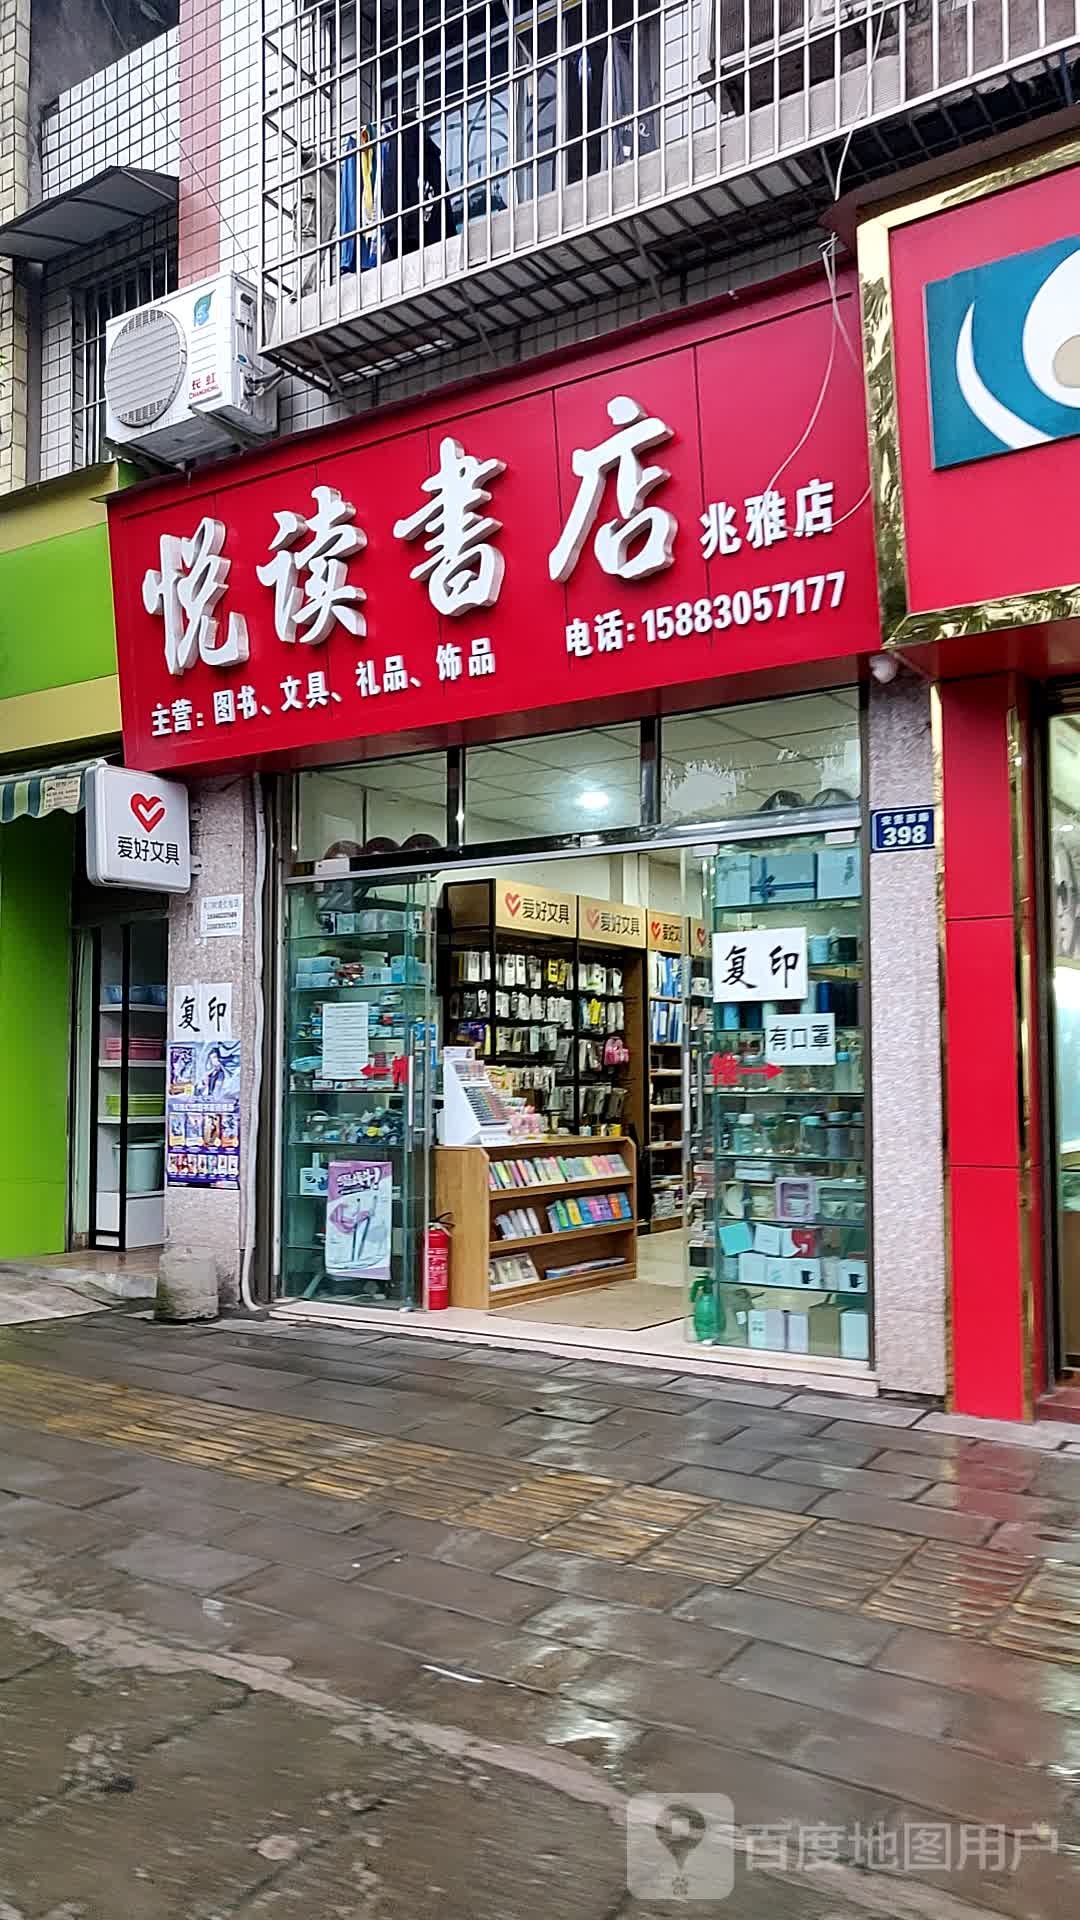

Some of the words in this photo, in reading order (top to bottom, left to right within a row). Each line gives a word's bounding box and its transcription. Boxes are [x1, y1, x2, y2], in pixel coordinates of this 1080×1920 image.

[700, 478, 834, 560] 兆雅店
[883, 824, 927, 846] 398
[117, 836, 180, 866] 爱好文具
[522, 897, 569, 925] 爱好文具
[600, 912, 640, 936] 爱好文具
[722, 944, 800, 989] 复印
[178, 995, 227, 1033] 复印
[769, 1024, 832, 1051] 有口罩
